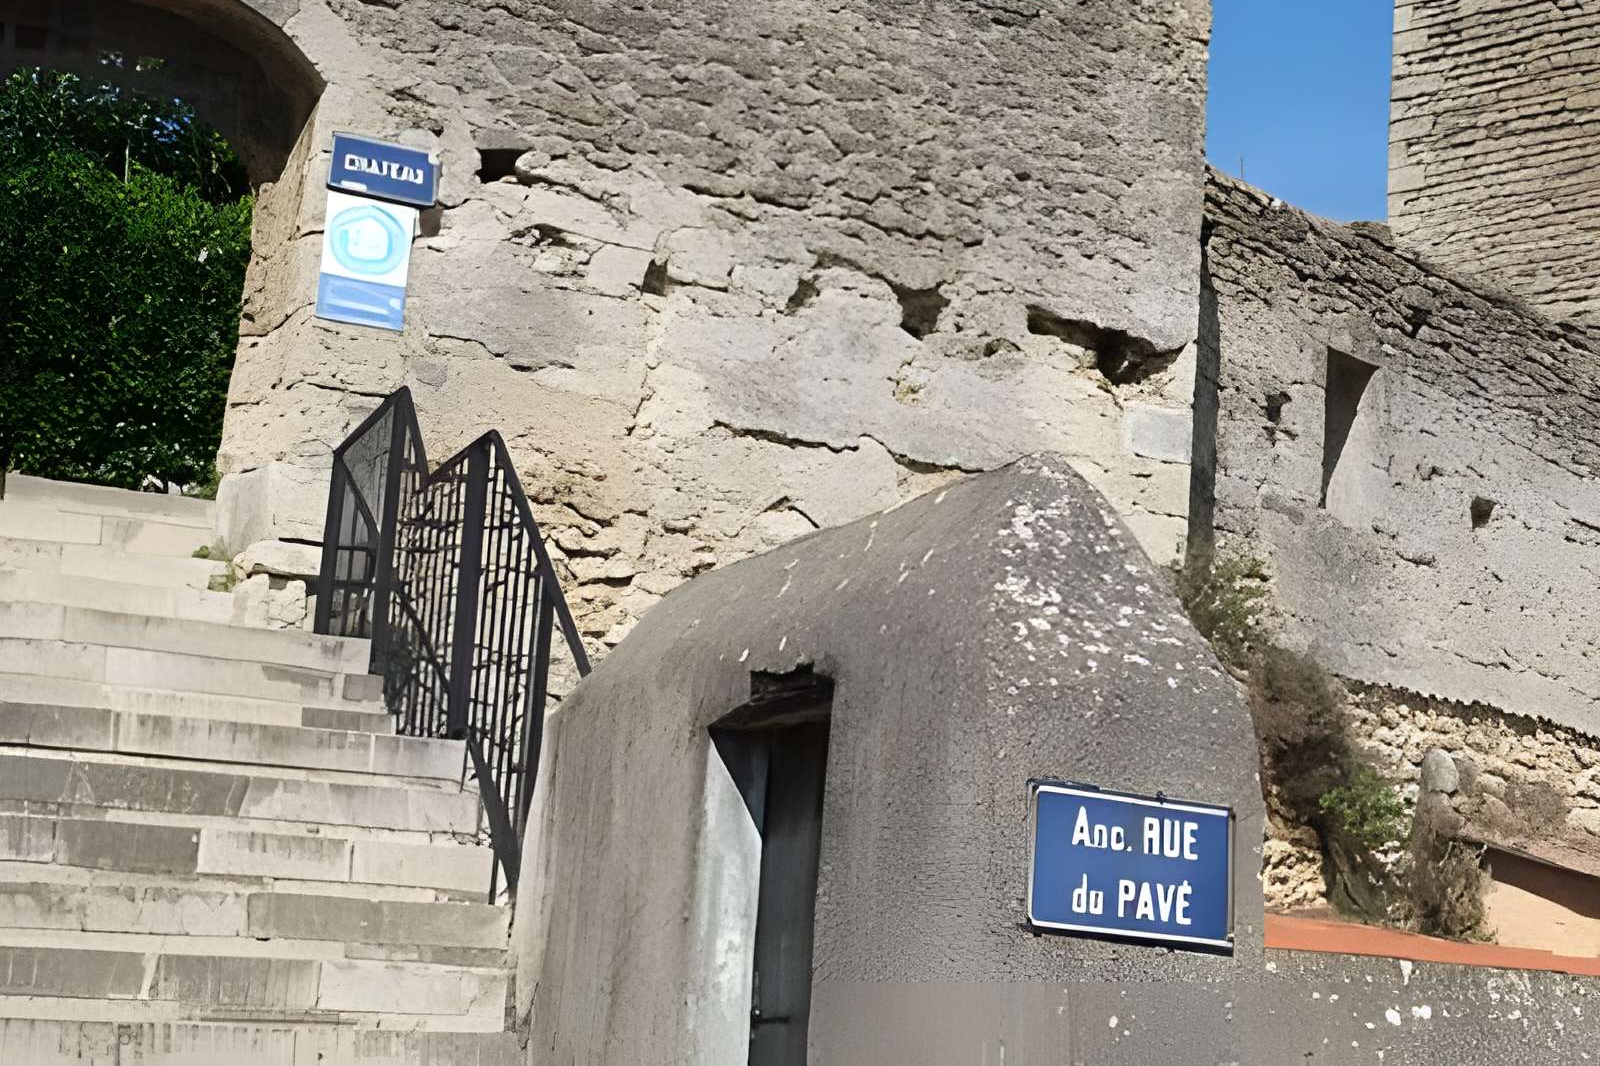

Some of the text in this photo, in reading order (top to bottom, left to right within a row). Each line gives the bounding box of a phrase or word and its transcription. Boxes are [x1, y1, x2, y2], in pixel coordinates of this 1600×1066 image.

[1071, 805, 1198, 860] Anc. RUE
[1071, 873, 1192, 925] du PAVÉ
